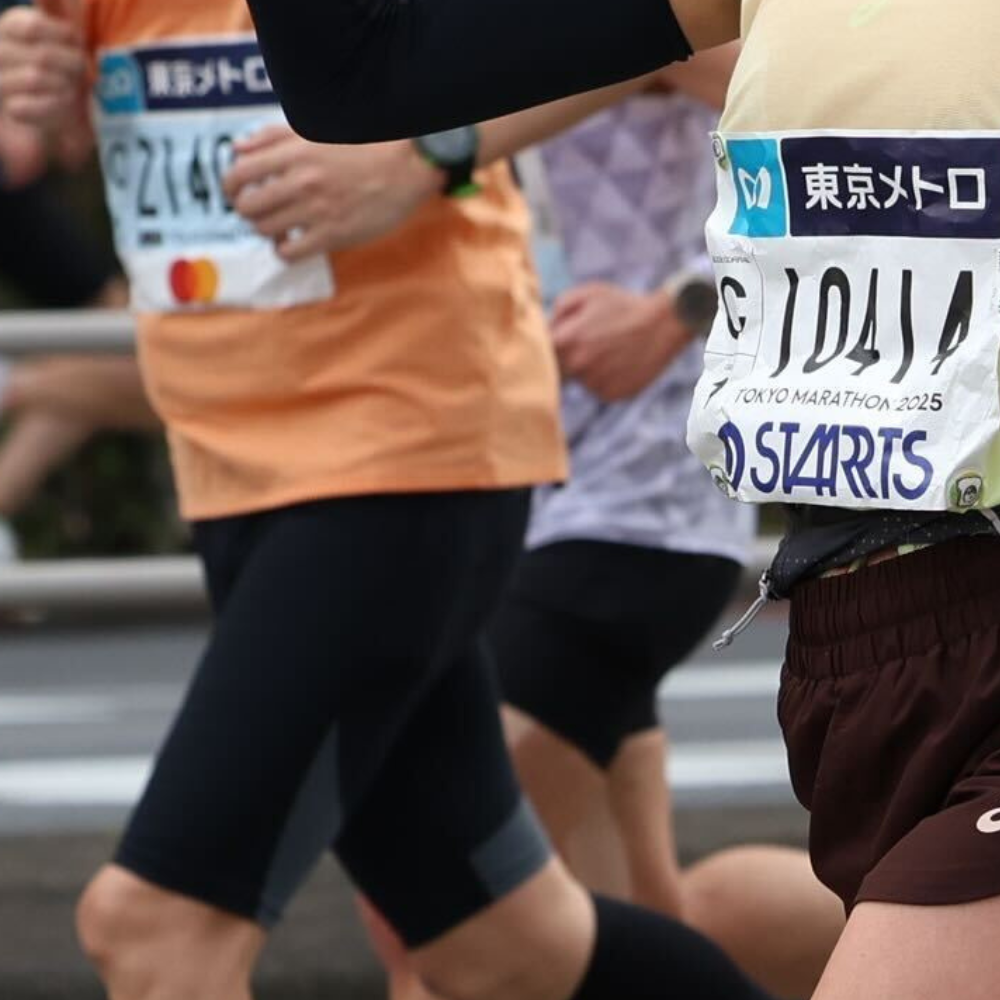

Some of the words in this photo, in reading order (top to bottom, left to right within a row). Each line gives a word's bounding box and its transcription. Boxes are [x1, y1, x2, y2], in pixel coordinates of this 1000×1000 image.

[800, 162, 986, 211] 東京メトロ
[720, 275, 747, 341] C
[769, 266, 973, 385] 10414
[736, 387, 789, 405] TOKYO
[793, 388, 890, 412] MARATHON
[894, 393, 943, 412] 2025
[749, 421, 935, 501] STARTS
